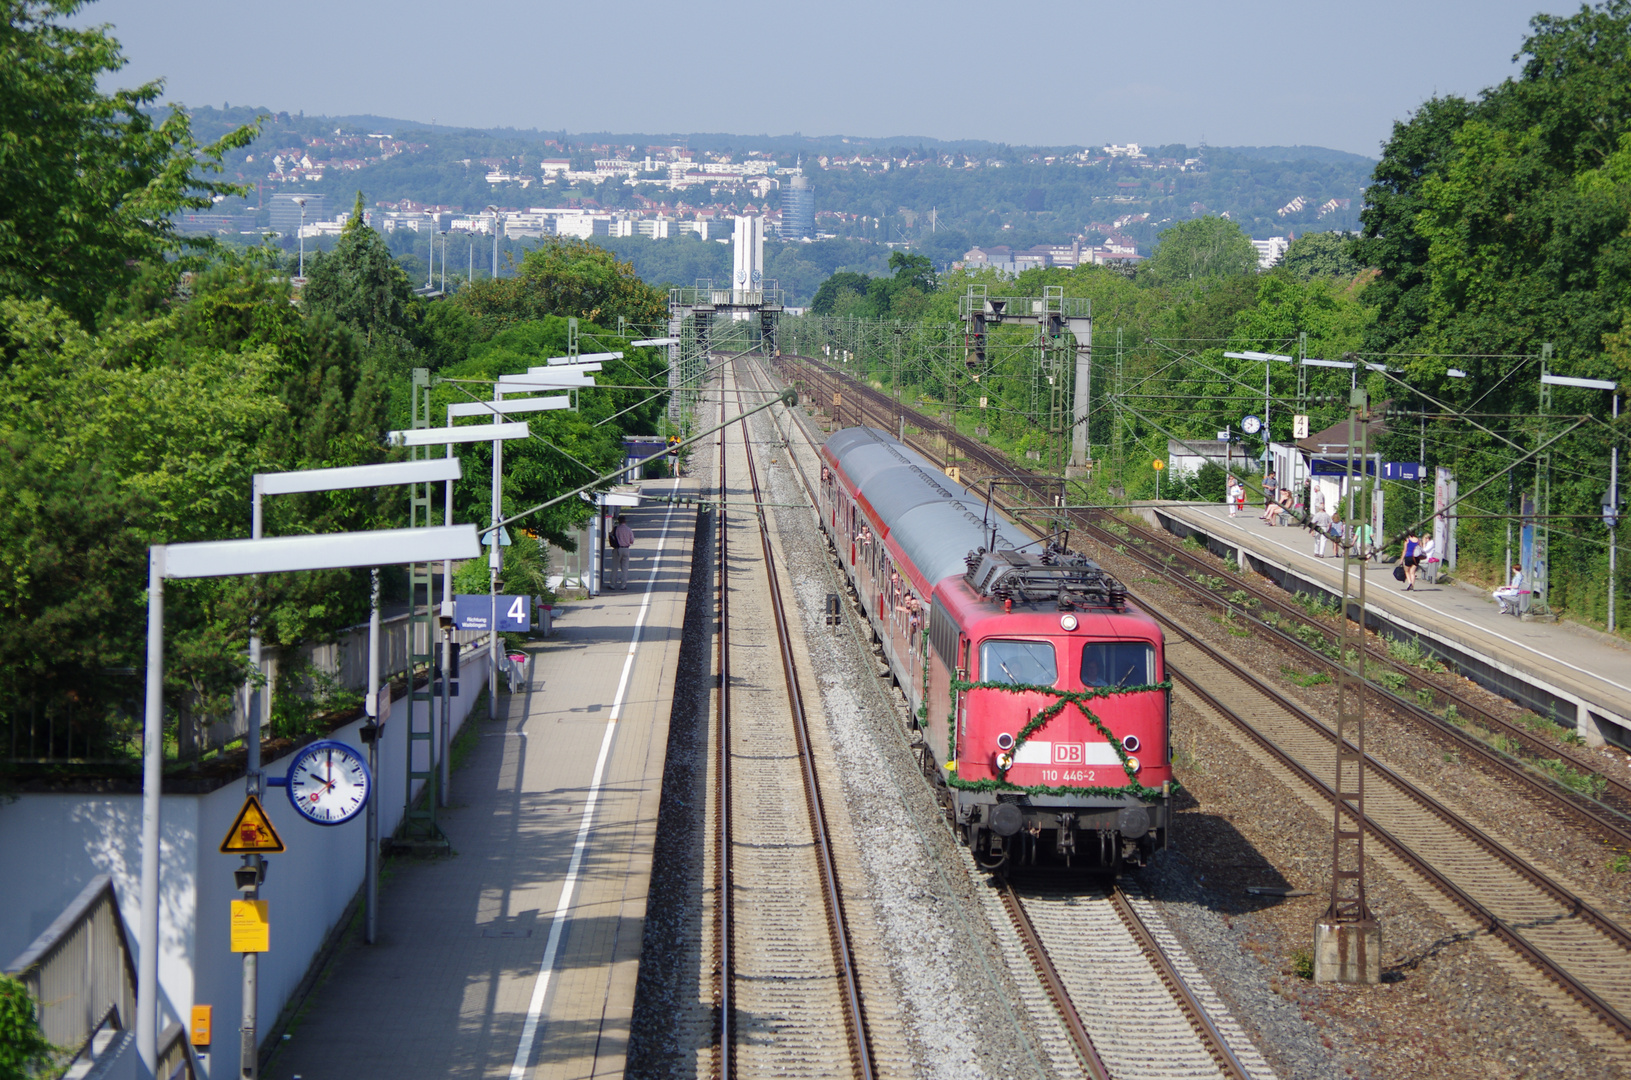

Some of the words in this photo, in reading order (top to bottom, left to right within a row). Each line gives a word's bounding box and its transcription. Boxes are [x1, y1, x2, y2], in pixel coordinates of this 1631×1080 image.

[1297, 417, 1304, 426] 4
[1297, 427, 1304, 436] 4
[949, 469, 955, 477] 4
[1384, 462, 1391, 476] 1
[507, 596, 526, 624] 4
[1057, 746, 1080, 761] DB
[1042, 770, 1058, 781] 110
[1063, 770, 1095, 782] 446-2
